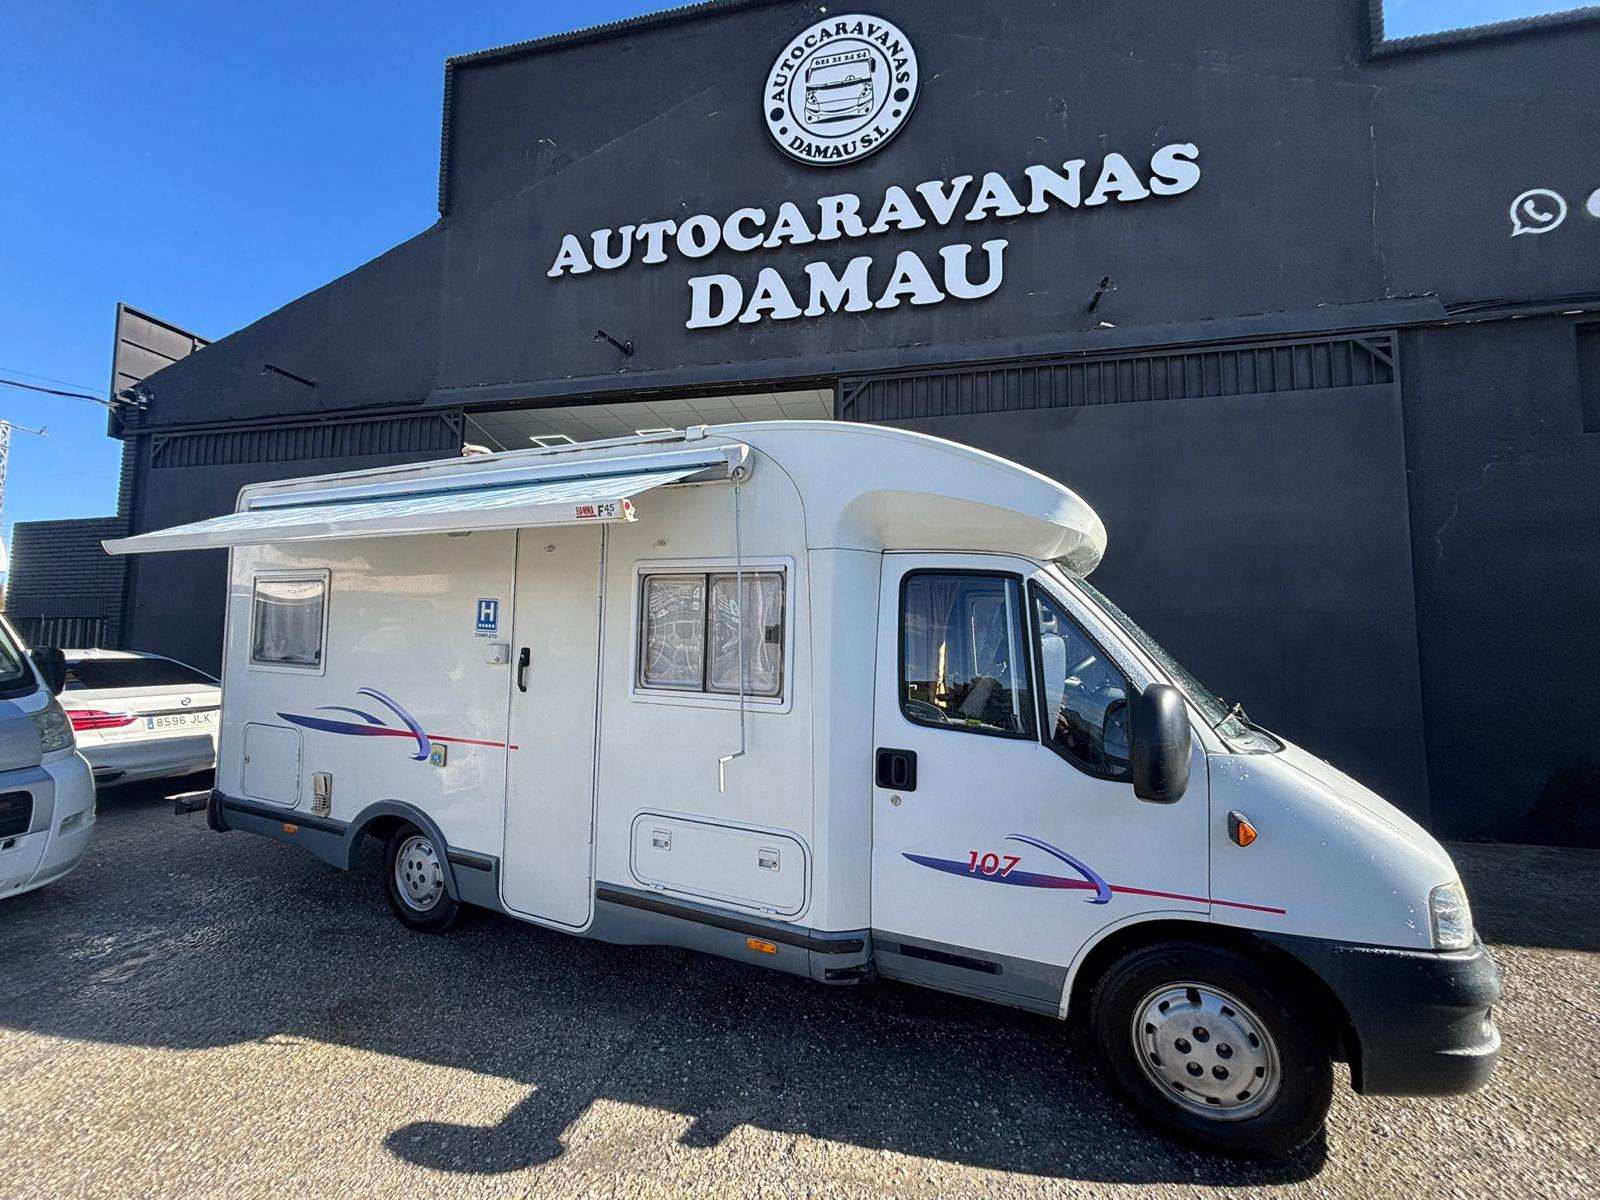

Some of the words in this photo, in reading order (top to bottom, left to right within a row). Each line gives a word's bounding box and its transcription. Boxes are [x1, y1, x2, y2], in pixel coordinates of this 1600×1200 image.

[771, 21, 910, 103] AUTOCARAVANAS
[788, 135, 857, 159] DAMAU
[860, 125, 889, 149] S.L
[547, 143, 1201, 278] AUTOCARAVANAS
[685, 239, 1009, 329] DAMAU
[480, 602, 495, 621] H
[156, 716, 186, 727] 8596
[190, 713, 211, 724] JLK
[967, 850, 1022, 878] 107
